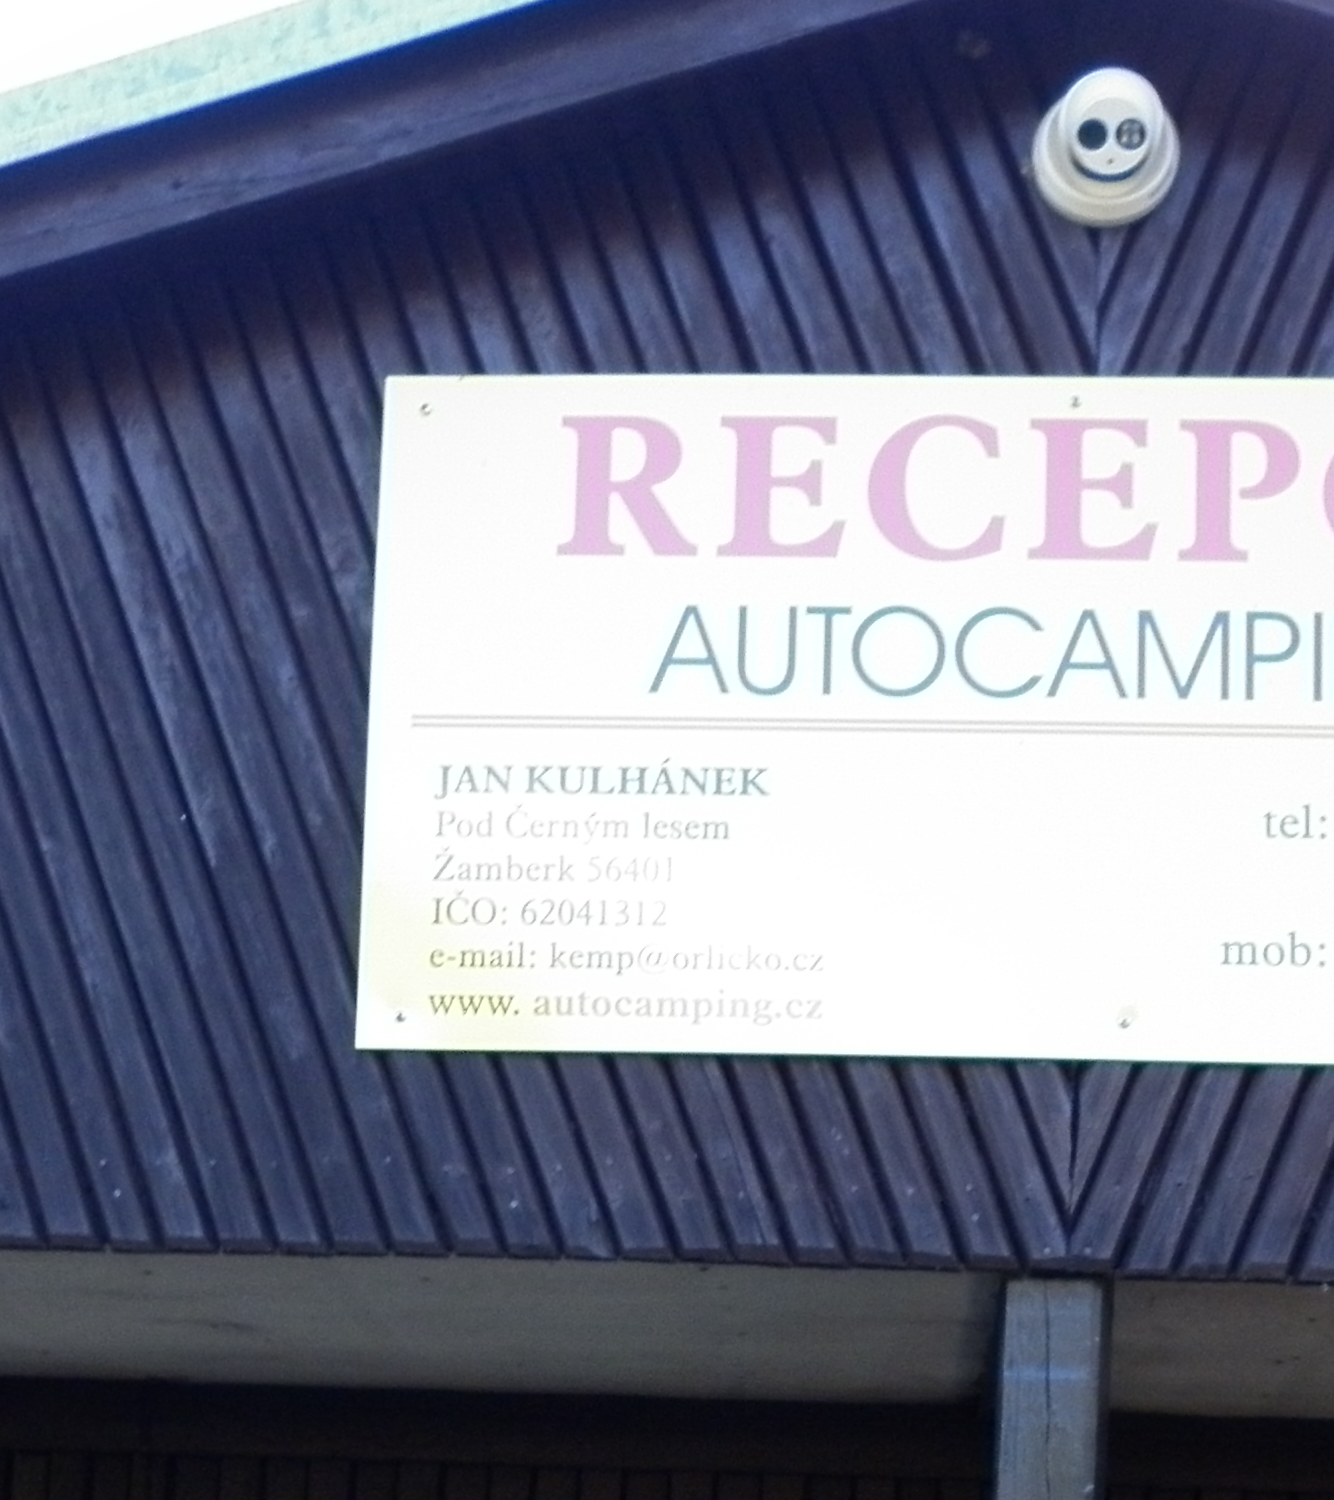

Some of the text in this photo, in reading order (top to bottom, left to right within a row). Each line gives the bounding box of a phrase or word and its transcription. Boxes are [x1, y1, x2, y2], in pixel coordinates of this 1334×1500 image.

[434, 757, 771, 800] JAN KULHÁNEK
[434, 803, 731, 846] Pod Černým lesem
[1264, 804, 1328, 840] tel:
[432, 845, 674, 884] Žamberk 56401
[430, 889, 668, 928] IČO: 62041312
[428, 941, 825, 977] e-mail: kemp@orlicko.cz
[1220, 930, 1328, 969] mob:
[428, 988, 825, 1027] www. autocamping.cz
